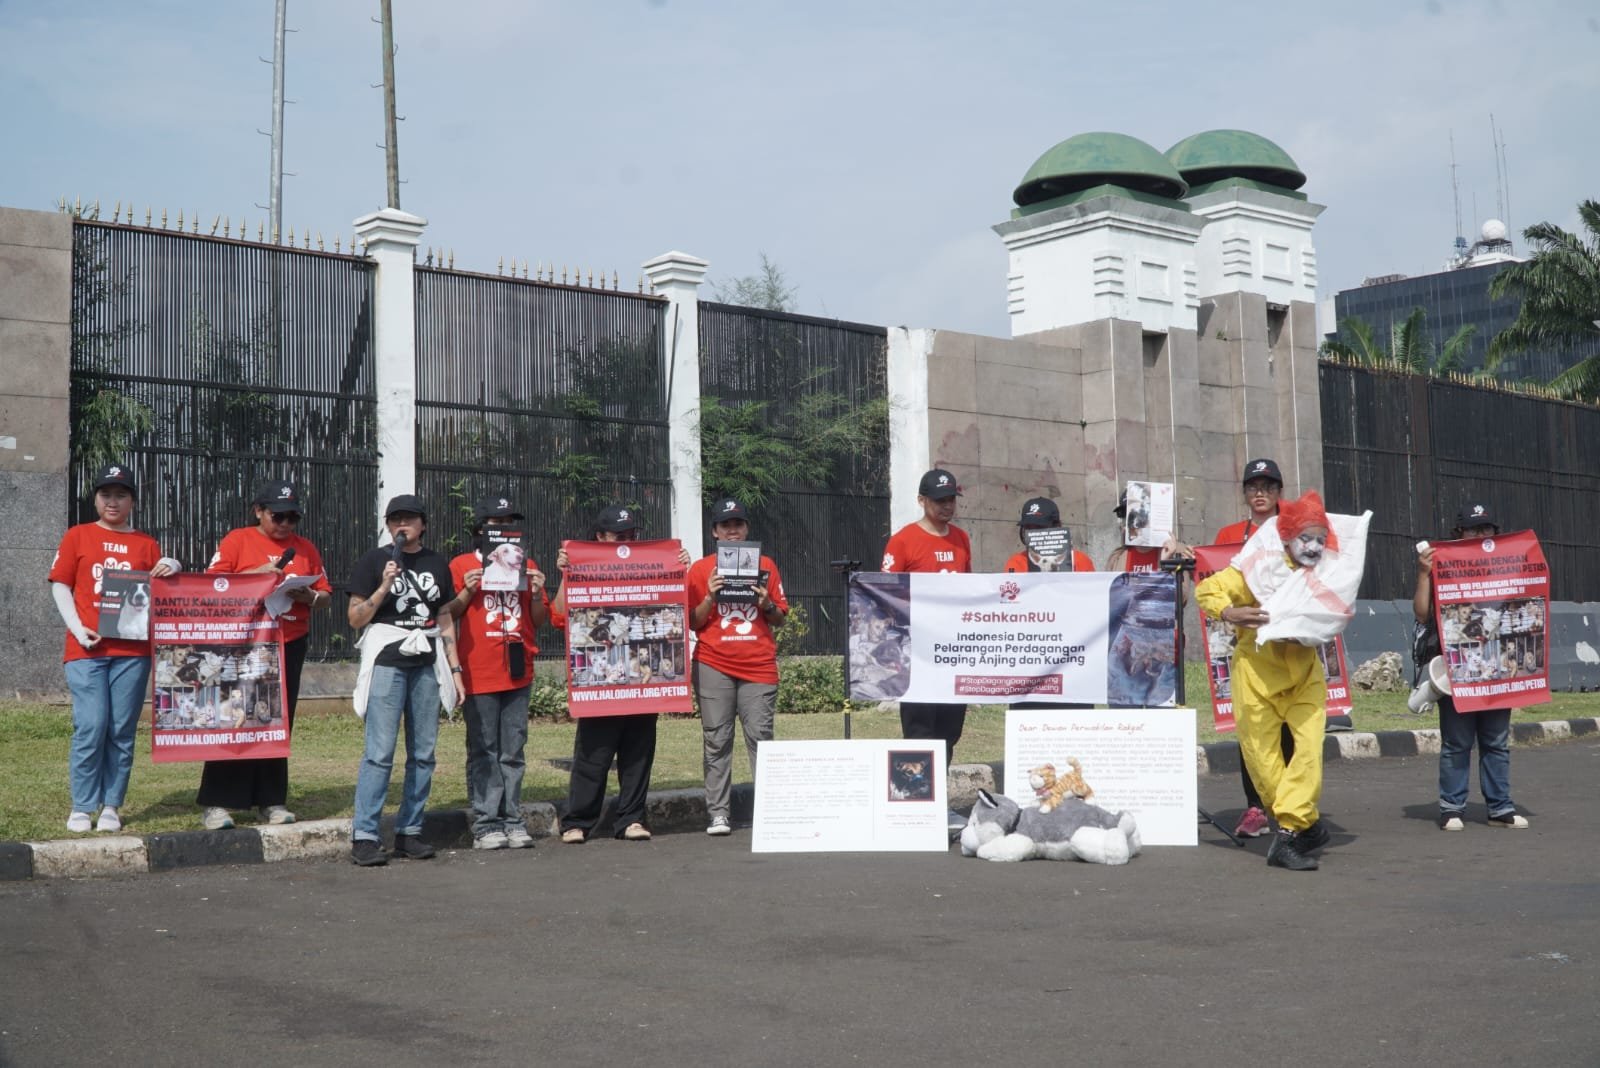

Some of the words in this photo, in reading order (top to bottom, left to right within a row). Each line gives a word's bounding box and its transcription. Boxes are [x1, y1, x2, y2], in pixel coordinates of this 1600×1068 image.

[102, 542, 128, 554] TEAM
[934, 551, 954, 562] TEAM
[567, 563, 598, 573] BANTU
[600, 563, 623, 572] KAMI
[625, 562, 664, 571] DENGAN
[1437, 559, 1466, 570] BANTU
[1468, 558, 1489, 567] KAMI
[1491, 555, 1528, 565] DENGAN
[567, 572, 656, 582] MENANDATANGANI
[657, 570, 684, 580] PETISI
[1437, 566, 1521, 579] MENANDATANGANI
[1522, 563, 1546, 573] PETISI
[567, 587, 587, 595] KAWAL
[589, 586, 602, 594] RUU
[603, 585, 641, 593] PELARANGAN
[642, 584, 685, 592] PERDAGANGAN
[154, 597, 190, 607] BANTU
[193, 597, 219, 607] KAMI
[568, 595, 590, 603] DAGING
[592, 595, 614, 603] ANJING
[615, 594, 628, 602] DAN
[154, 608, 256, 618] MENANDATANGANI
[961, 611, 1056, 623] #SahkanRUU
[154, 623, 176, 631] KAWAL
[178, 623, 193, 631] RUU
[194, 623, 238, 631] PELARANGAN
[154, 631, 179, 640] DAGING
[180, 631, 205, 640] ANJING
[207, 631, 221, 640] DAN
[223, 631, 247, 639] KUCING
[957, 632, 1014, 642] Indonesia
[1017, 632, 1063, 642] Darurat
[934, 643, 1002, 655] Pelarangan
[1005, 644, 1085, 656] Perdagangan
[934, 654, 976, 667] Daging
[978, 654, 1016, 667] Anjing
[1019, 655, 1042, 665] dan
[1044, 653, 1085, 667] Kucing
[961, 676, 1058, 686] #StopDagangDagingAnjing
[960, 684, 1059, 694] #StopDagangDagingKucing
[1453, 678, 1546, 697] WWW.HALODMFI.ORG/PETISI
[571, 685, 688, 702] WWW.HALODMFI.ORG/PETISI
[1018, 723, 1038, 732] Dear
[1042, 723, 1067, 732] Dewan
[155, 729, 286, 746] WWW.HALODMFI.ORG/PETISI
